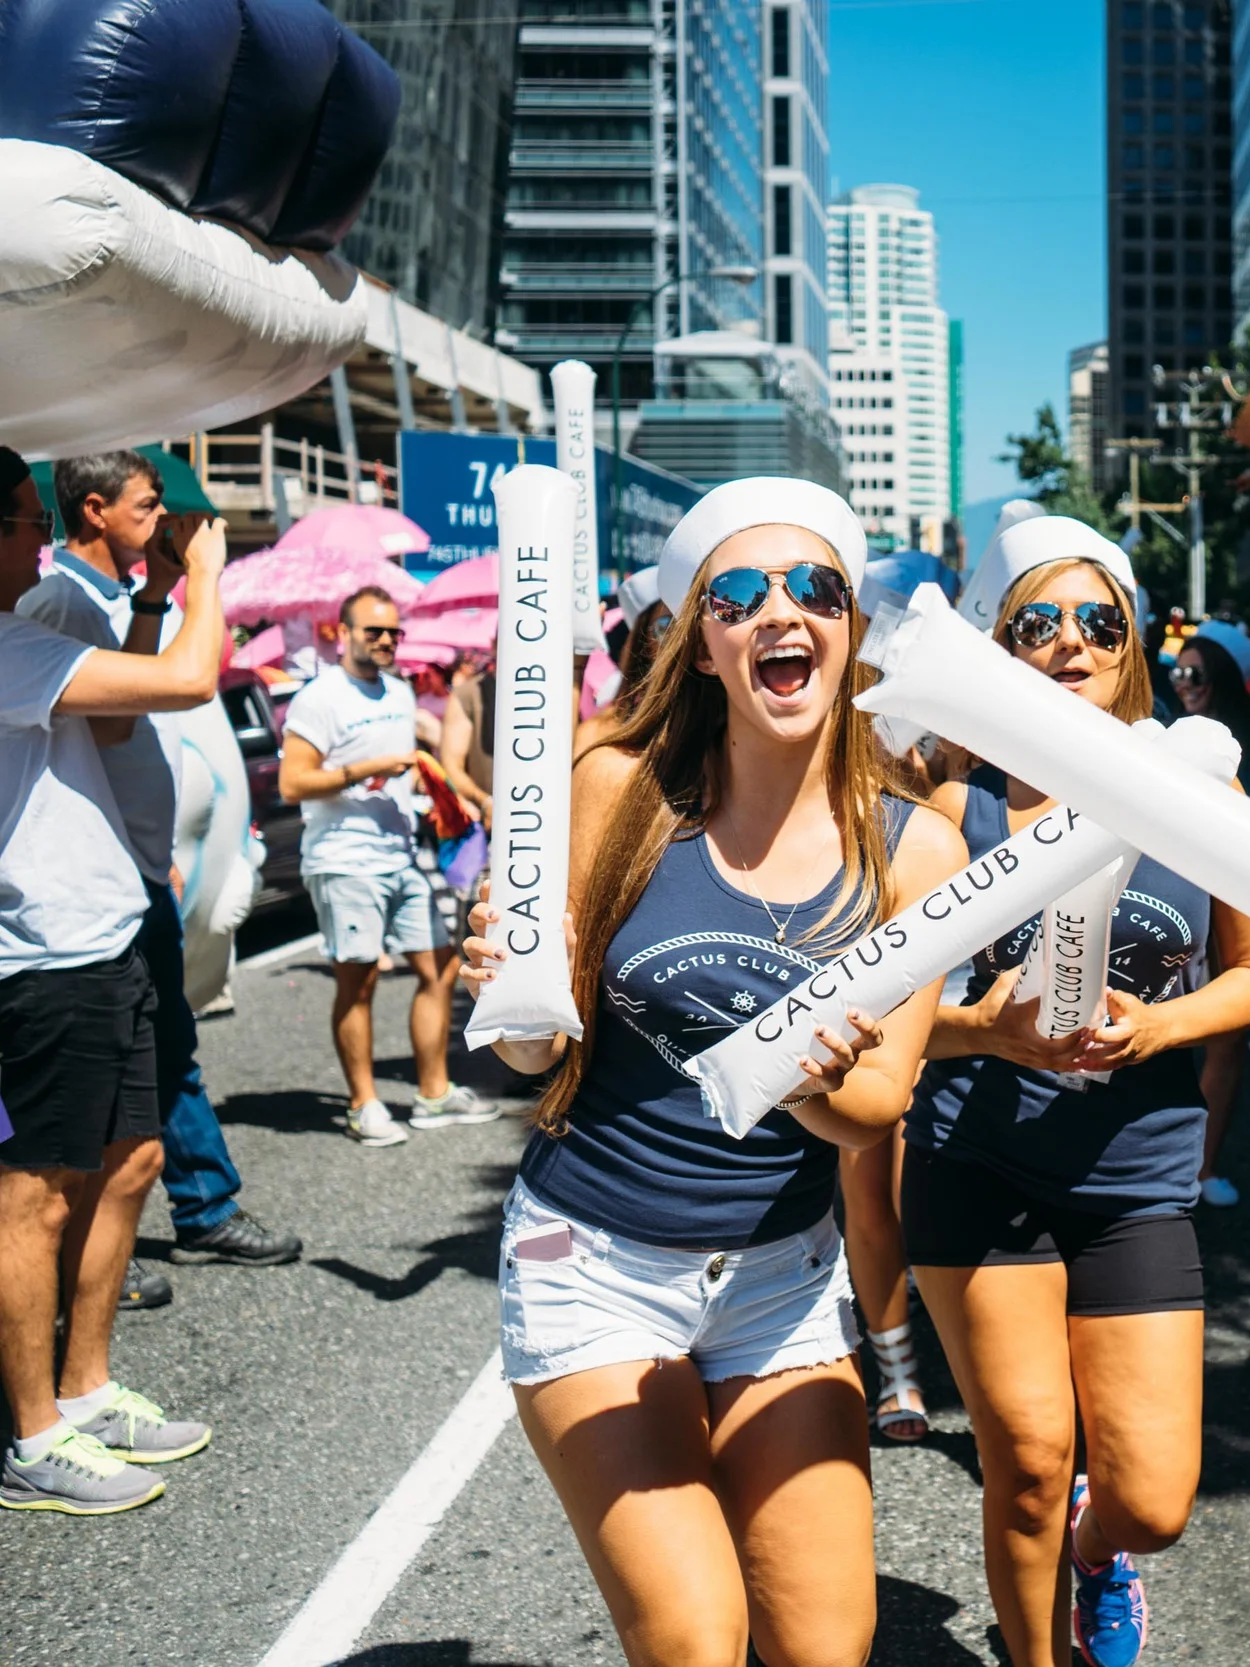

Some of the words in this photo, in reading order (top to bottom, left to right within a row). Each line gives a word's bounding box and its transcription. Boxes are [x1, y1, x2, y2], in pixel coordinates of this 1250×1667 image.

[568, 407, 585, 460] CAFE
[445, 502, 499, 527] THU
[515, 545, 549, 643] CAFE
[574, 529, 591, 614] CACTUS
[512, 663, 547, 762] CLUB
[507, 783, 544, 956] CACTUS
[755, 922, 907, 1043] CACTUS
[922, 847, 1020, 920] CLUB
[1056, 910, 1085, 959] CAFE
[1129, 912, 1168, 942] CAFE
[653, 953, 727, 984] CACTUS
[737, 955, 791, 981] CLUB
[1055, 963, 1083, 1003] CLUB
[1114, 957, 1132, 967] 14
